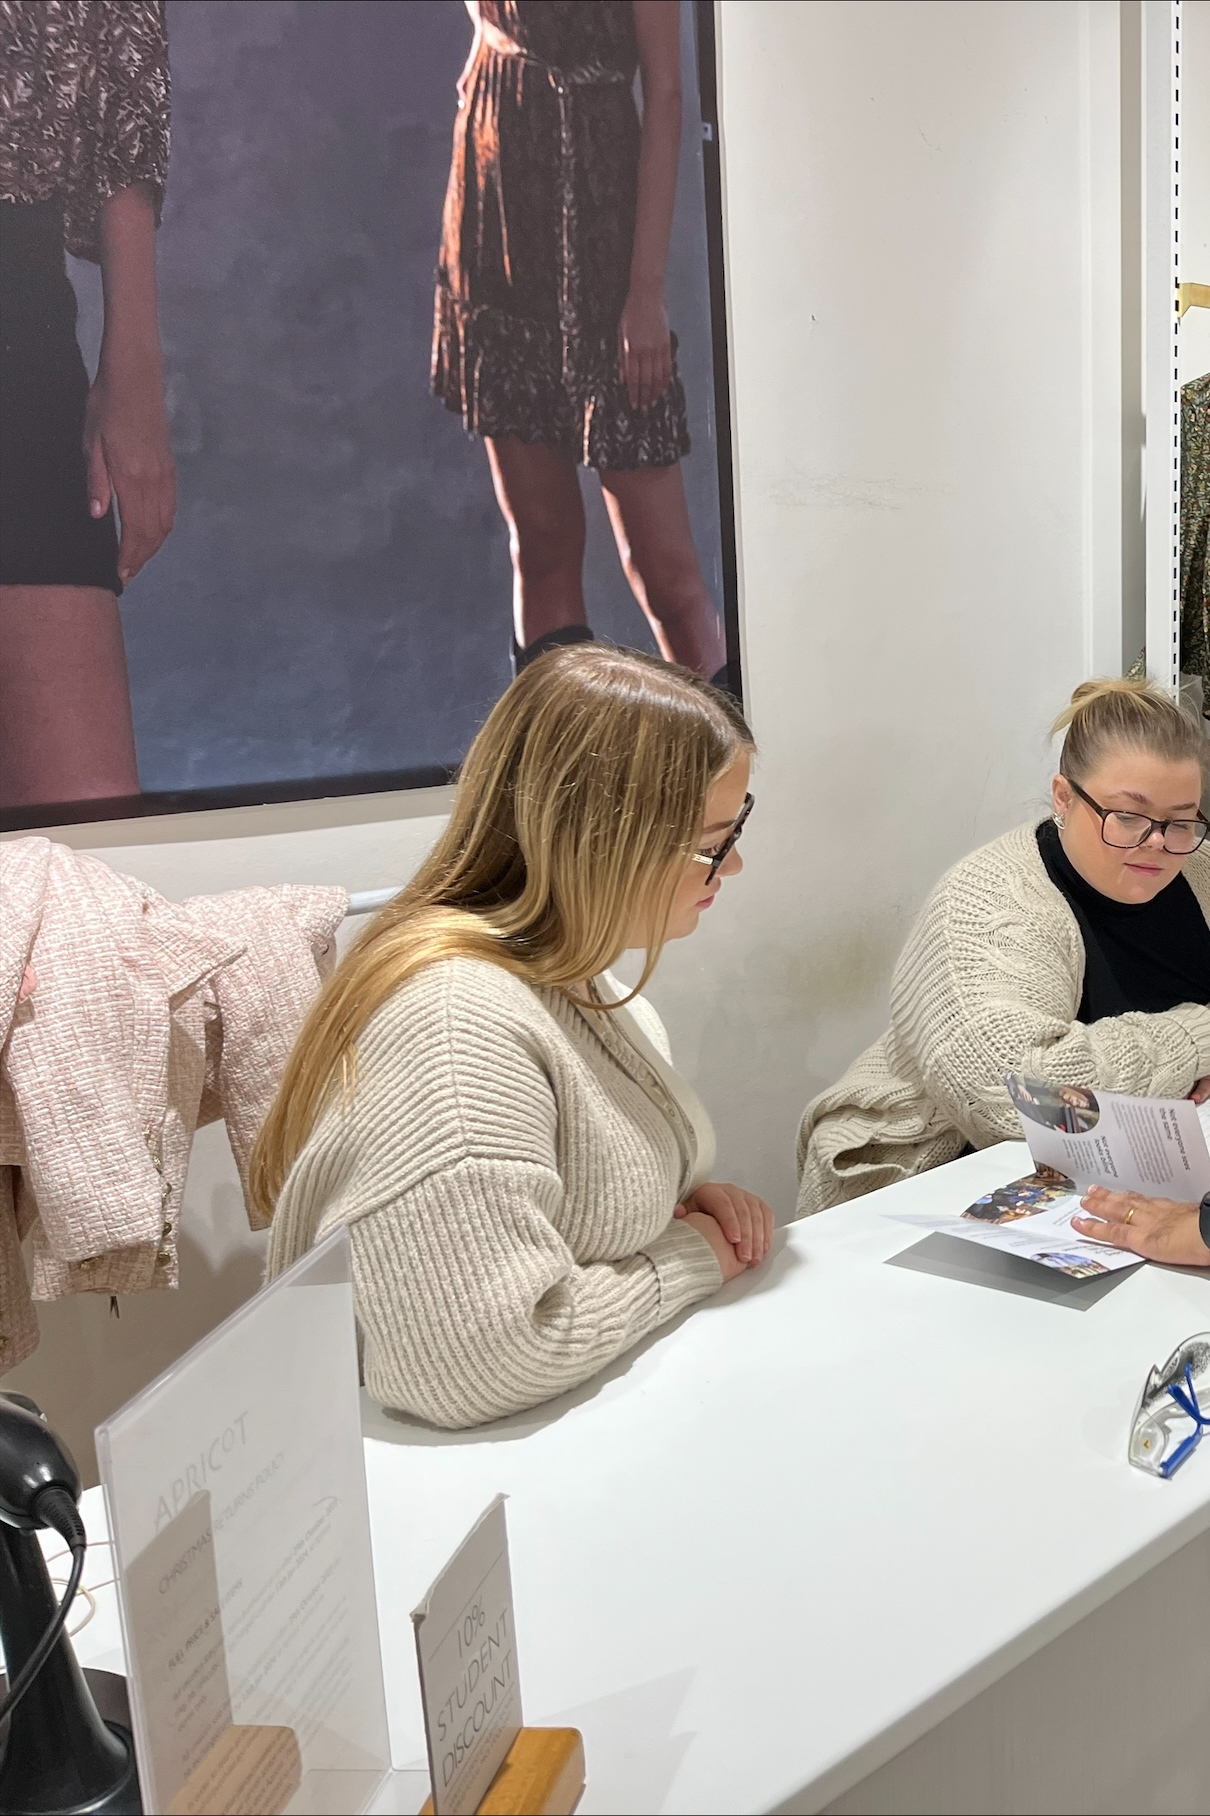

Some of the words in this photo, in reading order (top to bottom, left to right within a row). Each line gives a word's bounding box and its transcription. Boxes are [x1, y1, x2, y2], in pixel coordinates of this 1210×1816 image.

[1168, 1108, 1178, 1121] Not
[1172, 1122, 1186, 1155] everyone
[155, 1410, 249, 1533] APRICOT
[158, 1527, 212, 1595] CHRISTMAS
[213, 1482, 255, 1532] RETURNS
[437, 1607, 508, 1742] STUDENT
[457, 1594, 487, 1659] 10%
[442, 1649, 512, 1788] DISCOUNT
